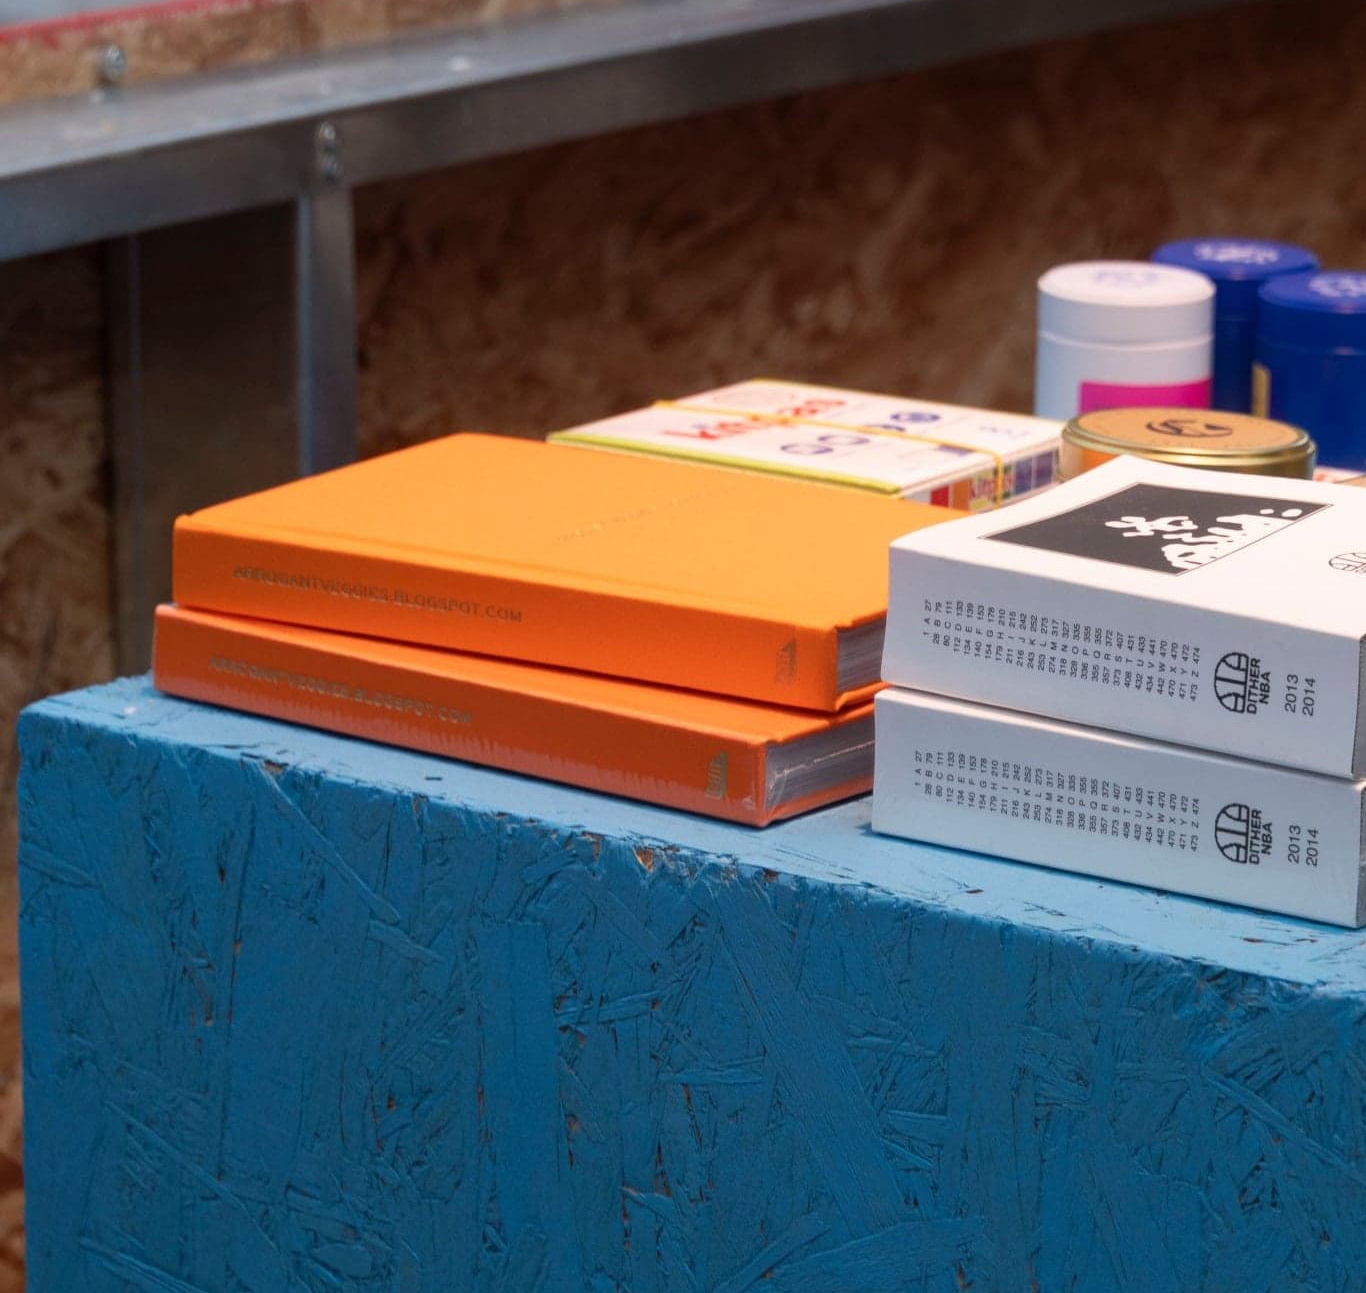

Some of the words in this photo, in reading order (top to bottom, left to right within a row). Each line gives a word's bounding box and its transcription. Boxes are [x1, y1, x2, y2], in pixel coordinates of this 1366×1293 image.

[924, 599, 932, 612] 27
[934, 601, 942, 613] 79
[945, 601, 953, 615] 111
[956, 600, 964, 618] 133
[966, 602, 974, 619] 139
[976, 605, 985, 621] 153
[923, 617, 931, 625] A
[987, 606, 995, 623] 178
[998, 608, 1006, 627] 210
[1008, 610, 1017, 629] 215
[1018, 612, 1027, 631] 242
[933, 618, 942, 628] B
[944, 620, 952, 631] C
[954, 623, 963, 632] D
[964, 625, 973, 634] E
[975, 627, 983, 635] F
[1029, 614, 1038, 633] 252
[1040, 617, 1049, 635] 273
[1051, 619, 1059, 637] 317
[1061, 620, 1070, 640] 327
[932, 632, 940, 645] 28
[942, 634, 951, 648] 80
[986, 629, 994, 638] G
[996, 631, 1005, 640] H
[1018, 636, 1026, 644] J
[1071, 623, 1081, 643] 335
[1105, 629, 1113, 648] 372
[1116, 631, 1124, 650] 407
[952, 636, 962, 653] 112
[963, 639, 972, 656] 134
[974, 640, 983, 658] 140
[1028, 637, 1037, 646] K
[1039, 641, 1047, 650] L
[1050, 641, 1058, 651] M
[1060, 644, 1069, 653] N
[1127, 634, 1135, 652] 431
[1138, 635, 1146, 654] 433
[1148, 639, 1156, 656] 441
[1159, 640, 1168, 658] 470
[984, 643, 993, 659] 154
[995, 645, 1004, 661] 179
[1005, 648, 1014, 665] 211
[1015, 649, 1025, 667] 216
[1071, 645, 1080, 657] O
[1081, 648, 1090, 657] P
[1093, 650, 1101, 659] Q
[1103, 649, 1112, 661] R
[1114, 655, 1123, 663] S
[1170, 642, 1179, 661] 470
[1181, 643, 1190, 662] 472
[1192, 647, 1200, 665] 474
[1026, 650, 1036, 670] 243
[1037, 653, 1047, 672] 253
[1048, 656, 1057, 674] 274
[1058, 657, 1068, 676] 318
[1069, 658, 1079, 678] 328
[1136, 658, 1145, 667] U
[1147, 661, 1155, 669] V
[1158, 661, 1166, 673] W
[1080, 661, 1089, 680] 336
[1101, 666, 1111, 685] 357
[1111, 668, 1122, 687] 373
[1169, 666, 1177, 676] X
[1180, 667, 1188, 675] Y
[1191, 670, 1199, 678] Z
[1124, 670, 1133, 689] 408
[1134, 671, 1143, 691] 432
[1145, 674, 1154, 693] 434
[1156, 677, 1166, 695] 442
[1168, 678, 1176, 697] 470
[1247, 657, 1261, 715] DITHER
[1178, 682, 1187, 700] 471
[1189, 683, 1198, 702] 473
[1259, 671, 1271, 705] NBA
[1284, 673, 1299, 713] 2013
[1302, 678, 1316, 717] 2014
[914, 768, 922, 776] A
[935, 771, 944, 780] C
[946, 773, 955, 782] D
[968, 778, 976, 786] F
[979, 780, 987, 789] G
[990, 781, 998, 791] H
[1023, 788, 1031, 797] K
[1045, 792, 1053, 802] M
[1056, 794, 1064, 803] N
[1100, 803, 1109, 812] R
[1111, 805, 1120, 814] S
[1134, 810, 1143, 818] U
[1146, 812, 1154, 820] V
[1156, 812, 1165, 823] W
[1168, 816, 1176, 825] X
[1180, 818, 1188, 826] Y
[1191, 821, 1199, 829] Z
[1249, 808, 1262, 865] DITHER
[1261, 821, 1273, 856] NBA
[1287, 824, 1302, 864] 2013
[1306, 829, 1320, 867] 2014
